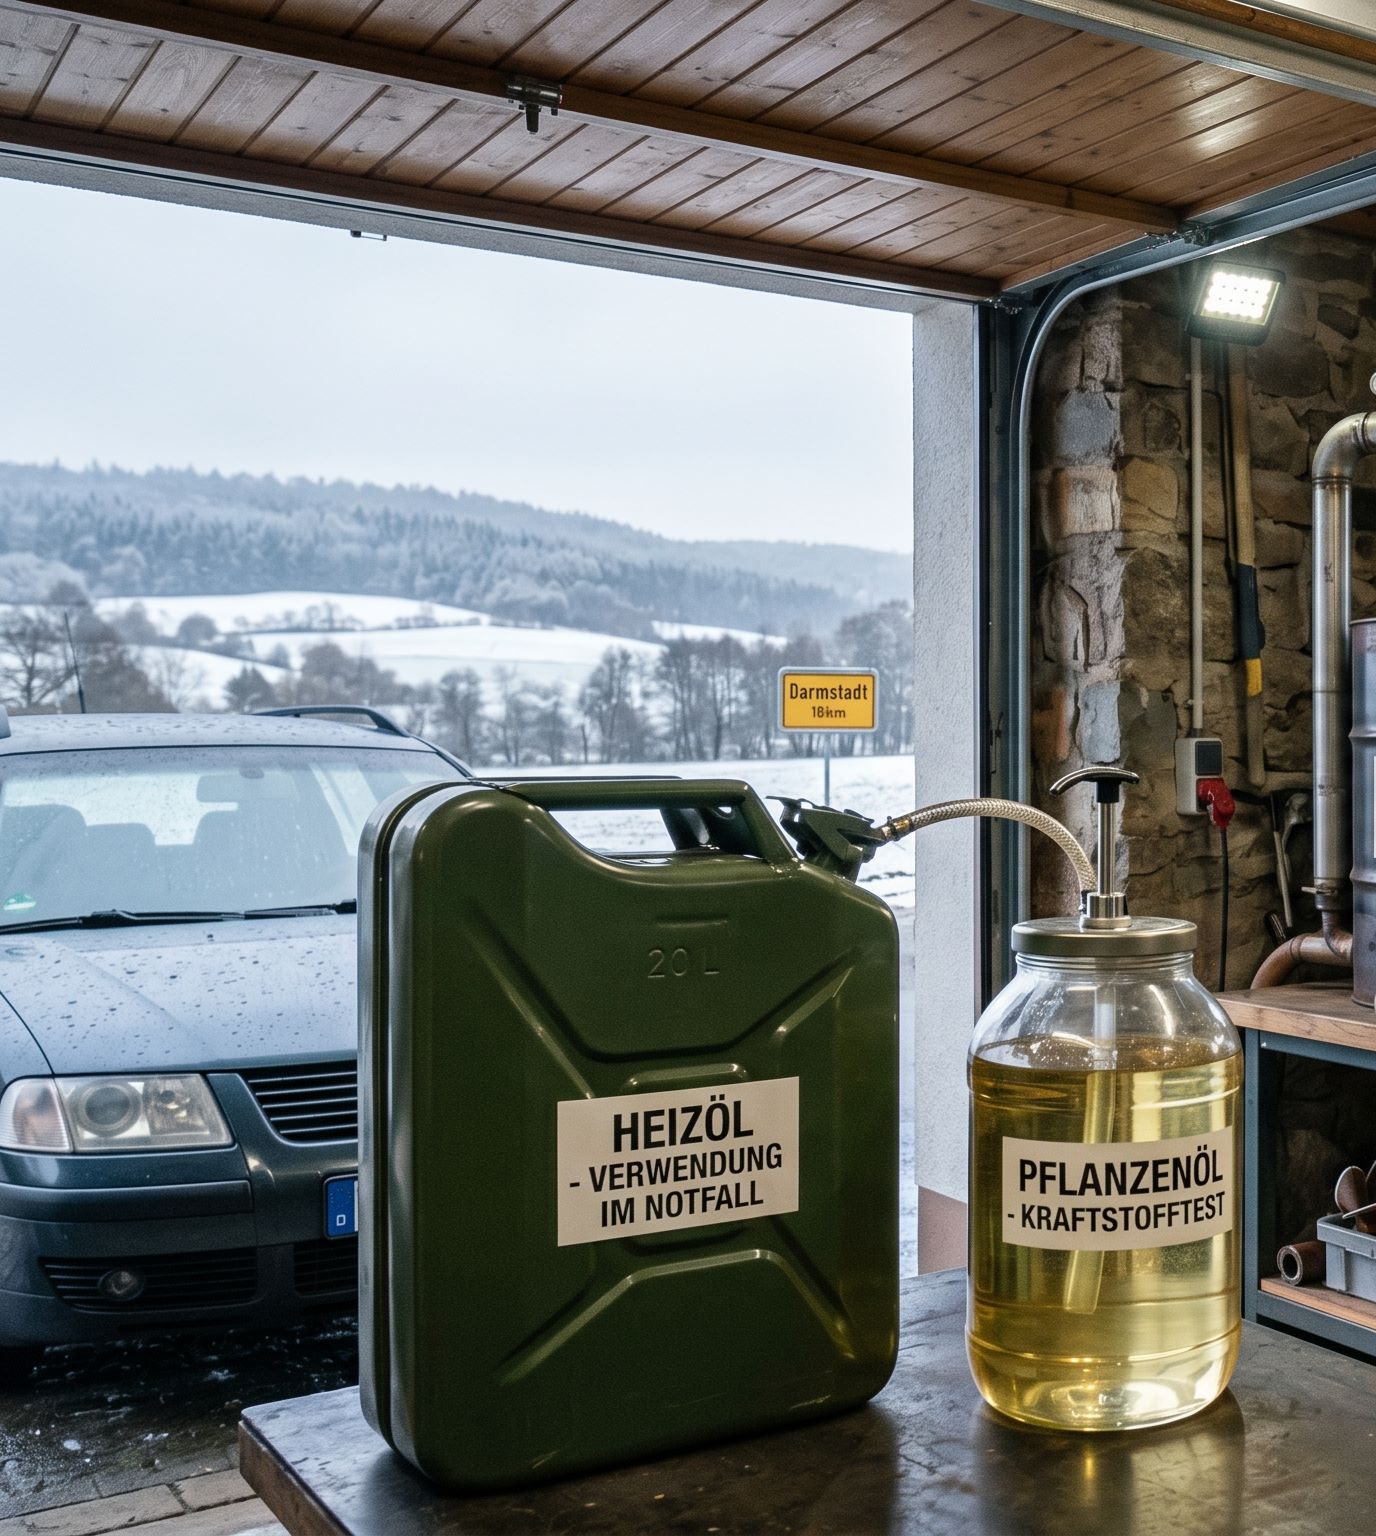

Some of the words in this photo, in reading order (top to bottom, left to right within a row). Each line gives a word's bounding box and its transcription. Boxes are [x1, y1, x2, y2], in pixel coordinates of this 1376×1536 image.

[790, 683, 868, 700] Darmstadt
[647, 947, 688, 979] 20
[613, 1093, 754, 1153] HEIZÖL
[588, 1142, 783, 1193] VERWENDUNG
[1019, 1143, 1224, 1197] PFLANZENÖL
[336, 1214, 346, 1227] D
[601, 1197, 635, 1228] IM
[645, 1180, 765, 1222] NOTFALL
[1021, 1191, 1226, 1233] KRAFTSTOFFTEST
